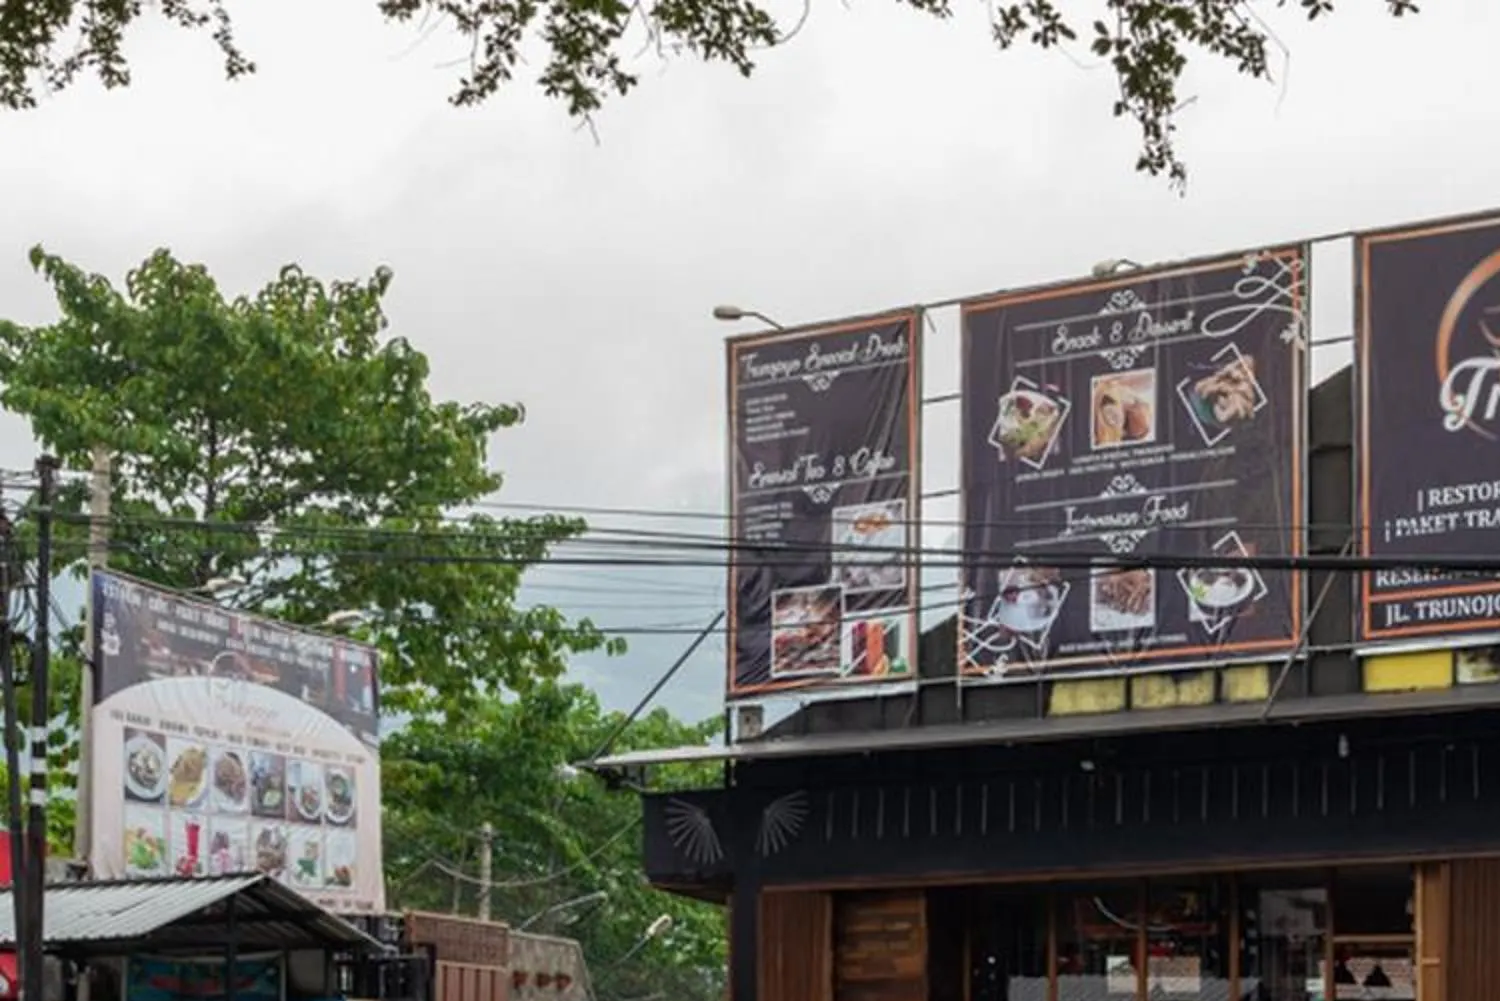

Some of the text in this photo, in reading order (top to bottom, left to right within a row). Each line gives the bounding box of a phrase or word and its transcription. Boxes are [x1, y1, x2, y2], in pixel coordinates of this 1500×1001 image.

[1143, 496, 1188, 525] Food
[1395, 512, 1459, 537] PAKET
[1386, 603, 1410, 627] JL.
